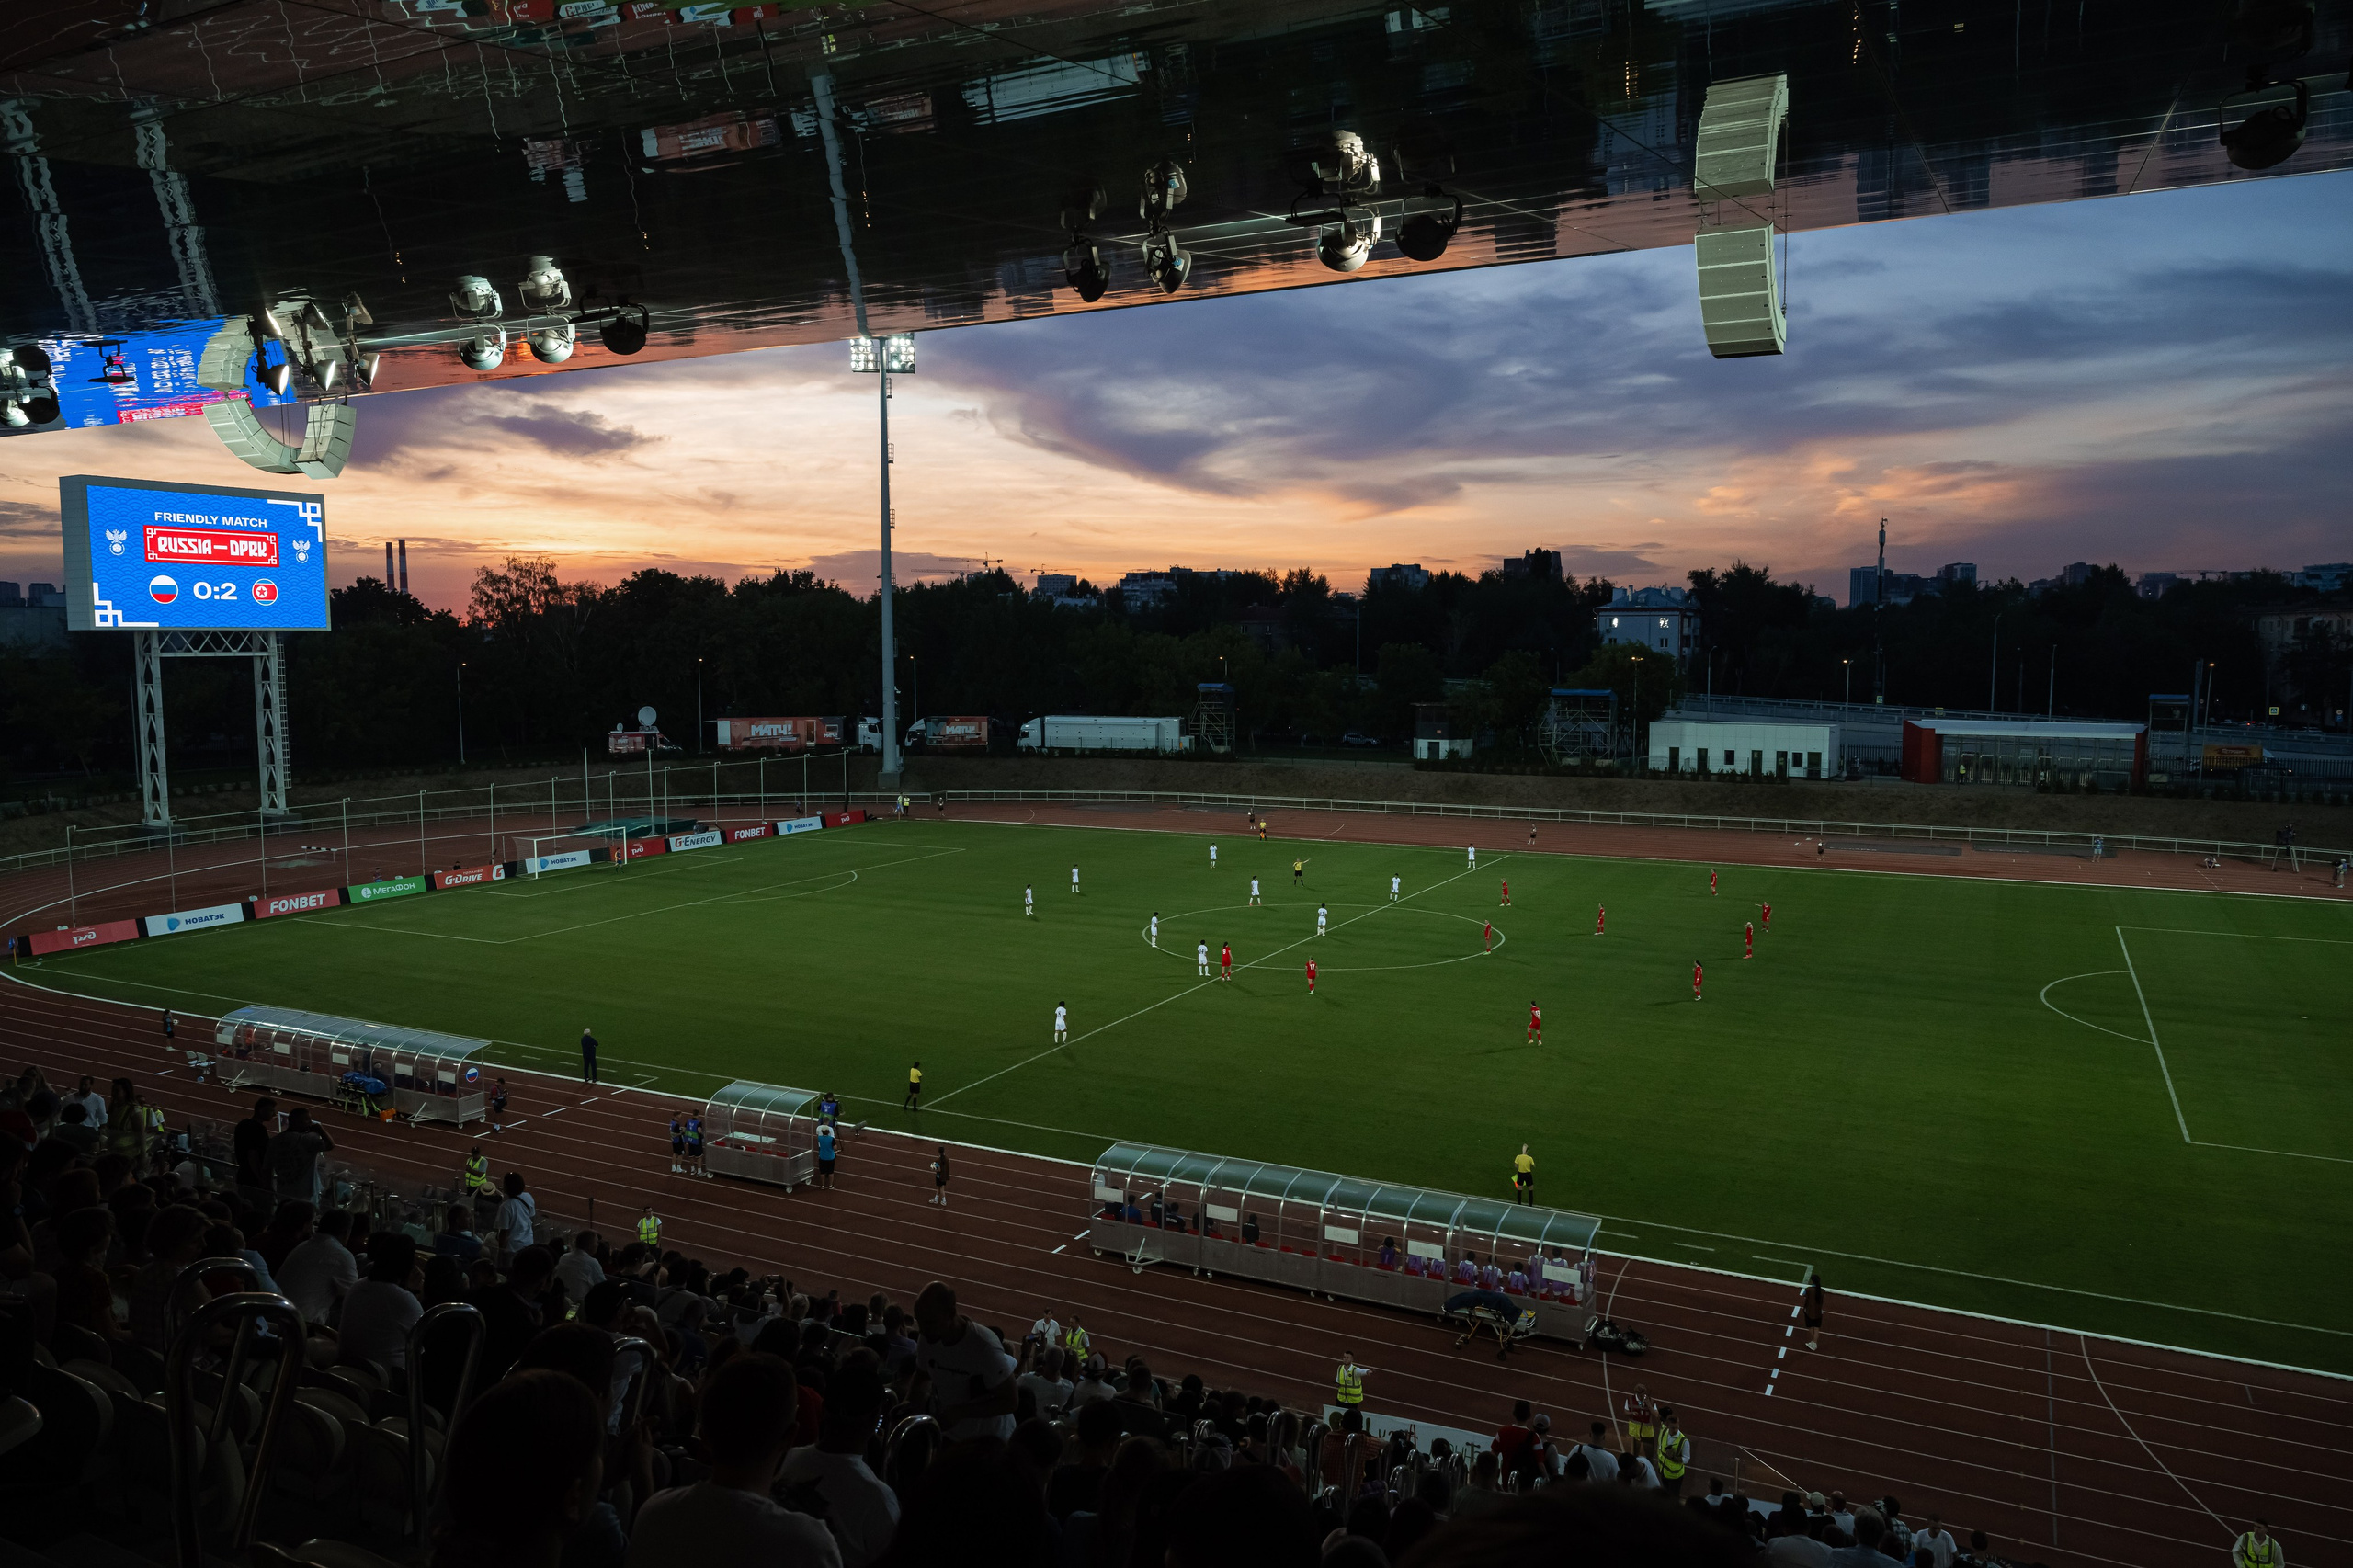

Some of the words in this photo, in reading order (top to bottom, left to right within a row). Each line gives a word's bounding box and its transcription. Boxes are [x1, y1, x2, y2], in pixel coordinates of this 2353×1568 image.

[154, 511, 219, 525] FRIENDLY
[222, 516, 268, 528] MATCH
[192, 581, 237, 600] 0:2
[734, 826, 766, 840] FONBET
[551, 857, 577, 865] НОВАТЭК
[269, 893, 326, 914] FONBET
[185, 913, 225, 926] НОВАТЭК
